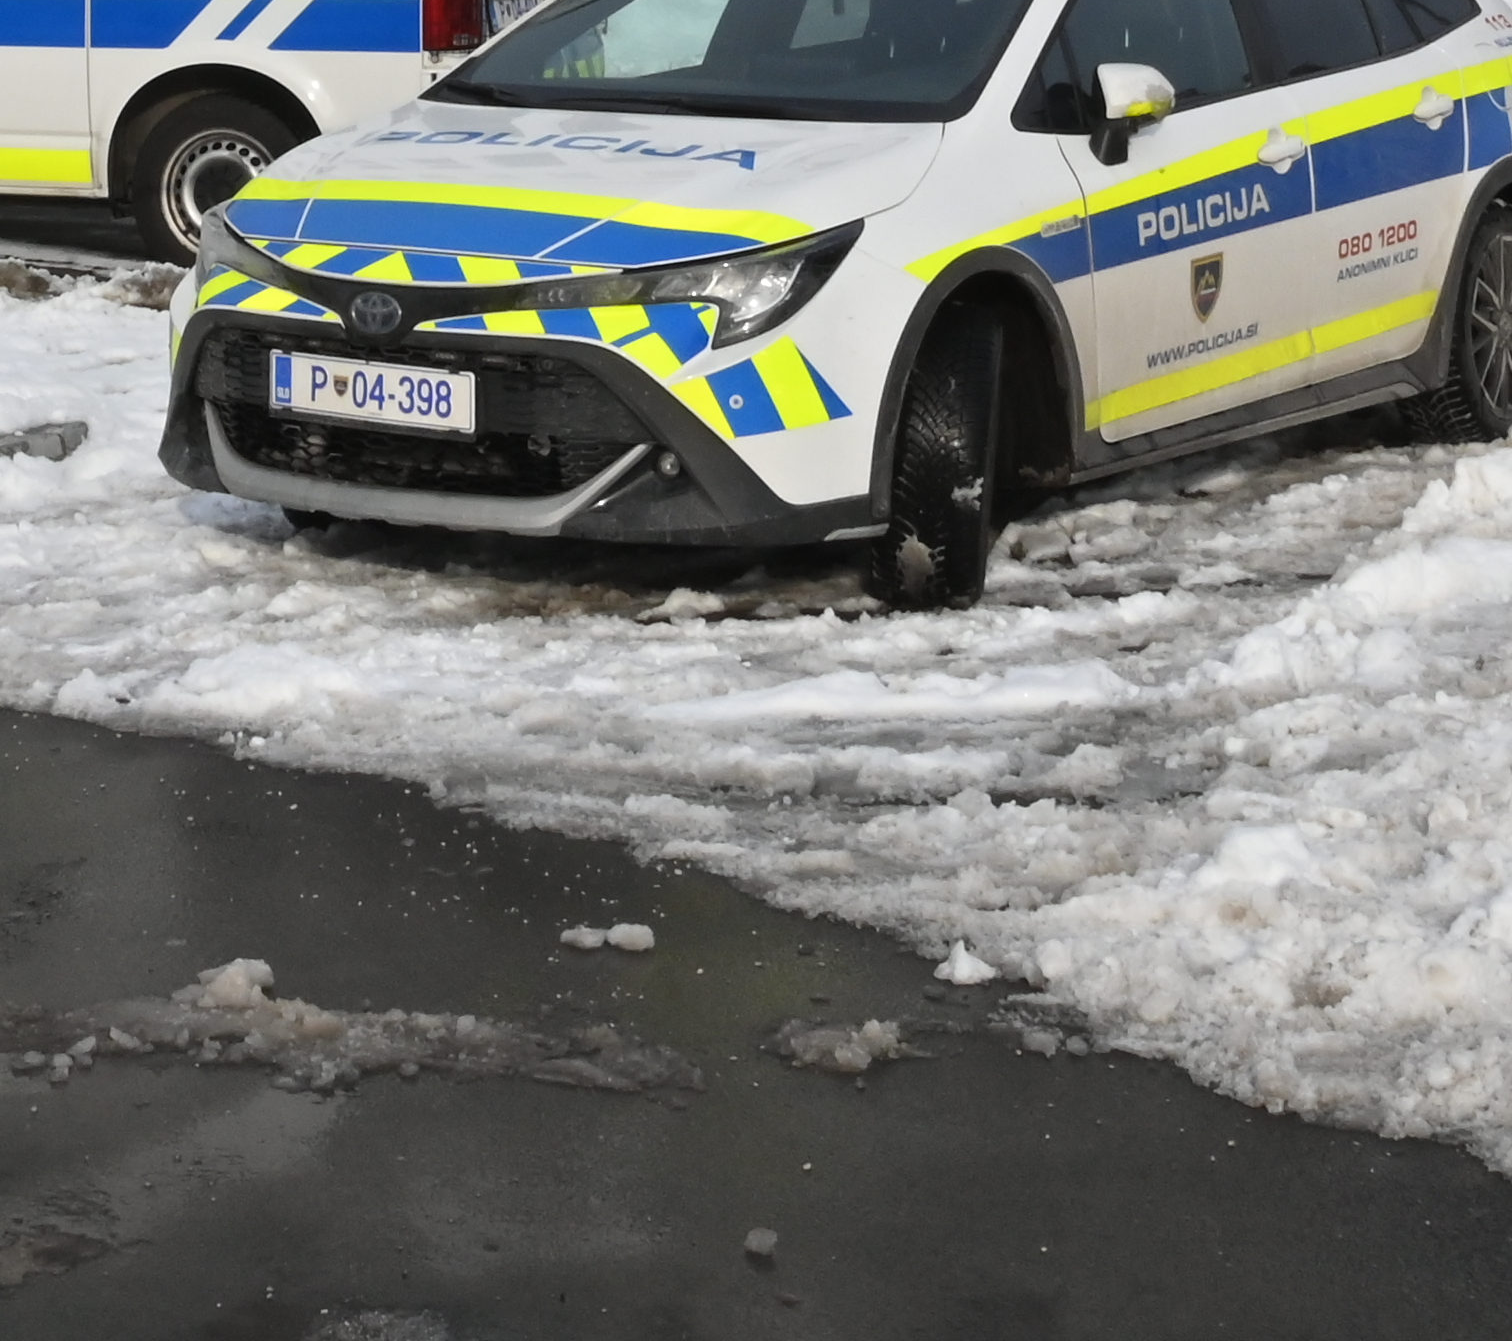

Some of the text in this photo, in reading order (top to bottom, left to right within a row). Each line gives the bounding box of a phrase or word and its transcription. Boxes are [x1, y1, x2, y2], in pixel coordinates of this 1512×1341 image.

[1485, 14, 1512, 31] 113
[356, 130, 756, 170] POLICIJA
[1137, 183, 1270, 247] POLICIJA
[1338, 220, 1417, 259] 080 1200
[1337, 247, 1418, 282] ANONIMNI KLICI
[1147, 323, 1258, 369] WWW.POLICIJA.SI
[276, 387, 290, 399] SLO
[310, 365, 452, 418] P 04-398
